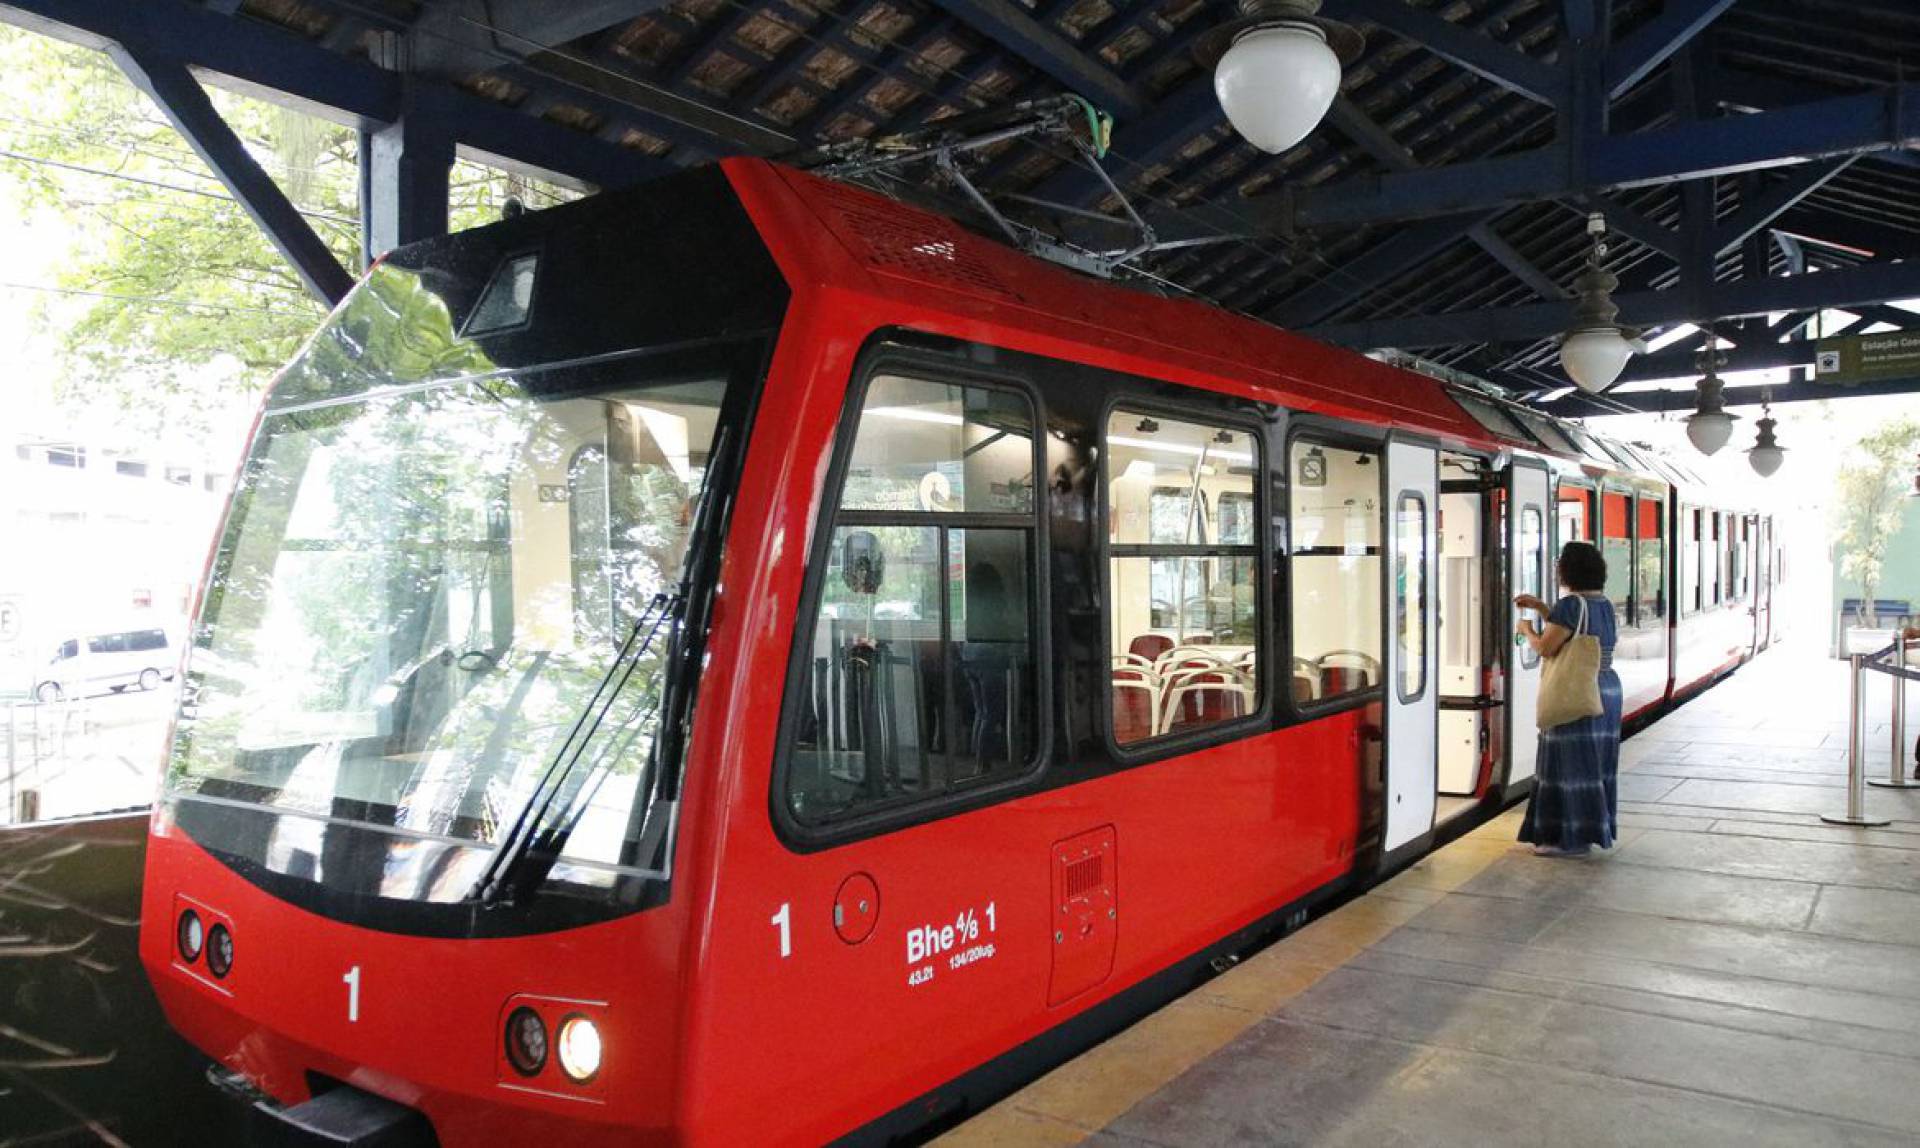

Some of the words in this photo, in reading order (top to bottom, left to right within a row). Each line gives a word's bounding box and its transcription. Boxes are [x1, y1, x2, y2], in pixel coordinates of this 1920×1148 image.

[771, 902, 791, 957] 1
[907, 923, 955, 965] Bhe
[956, 907, 979, 944] 4/8
[985, 901, 996, 932] 1
[343, 965, 360, 1021] 1
